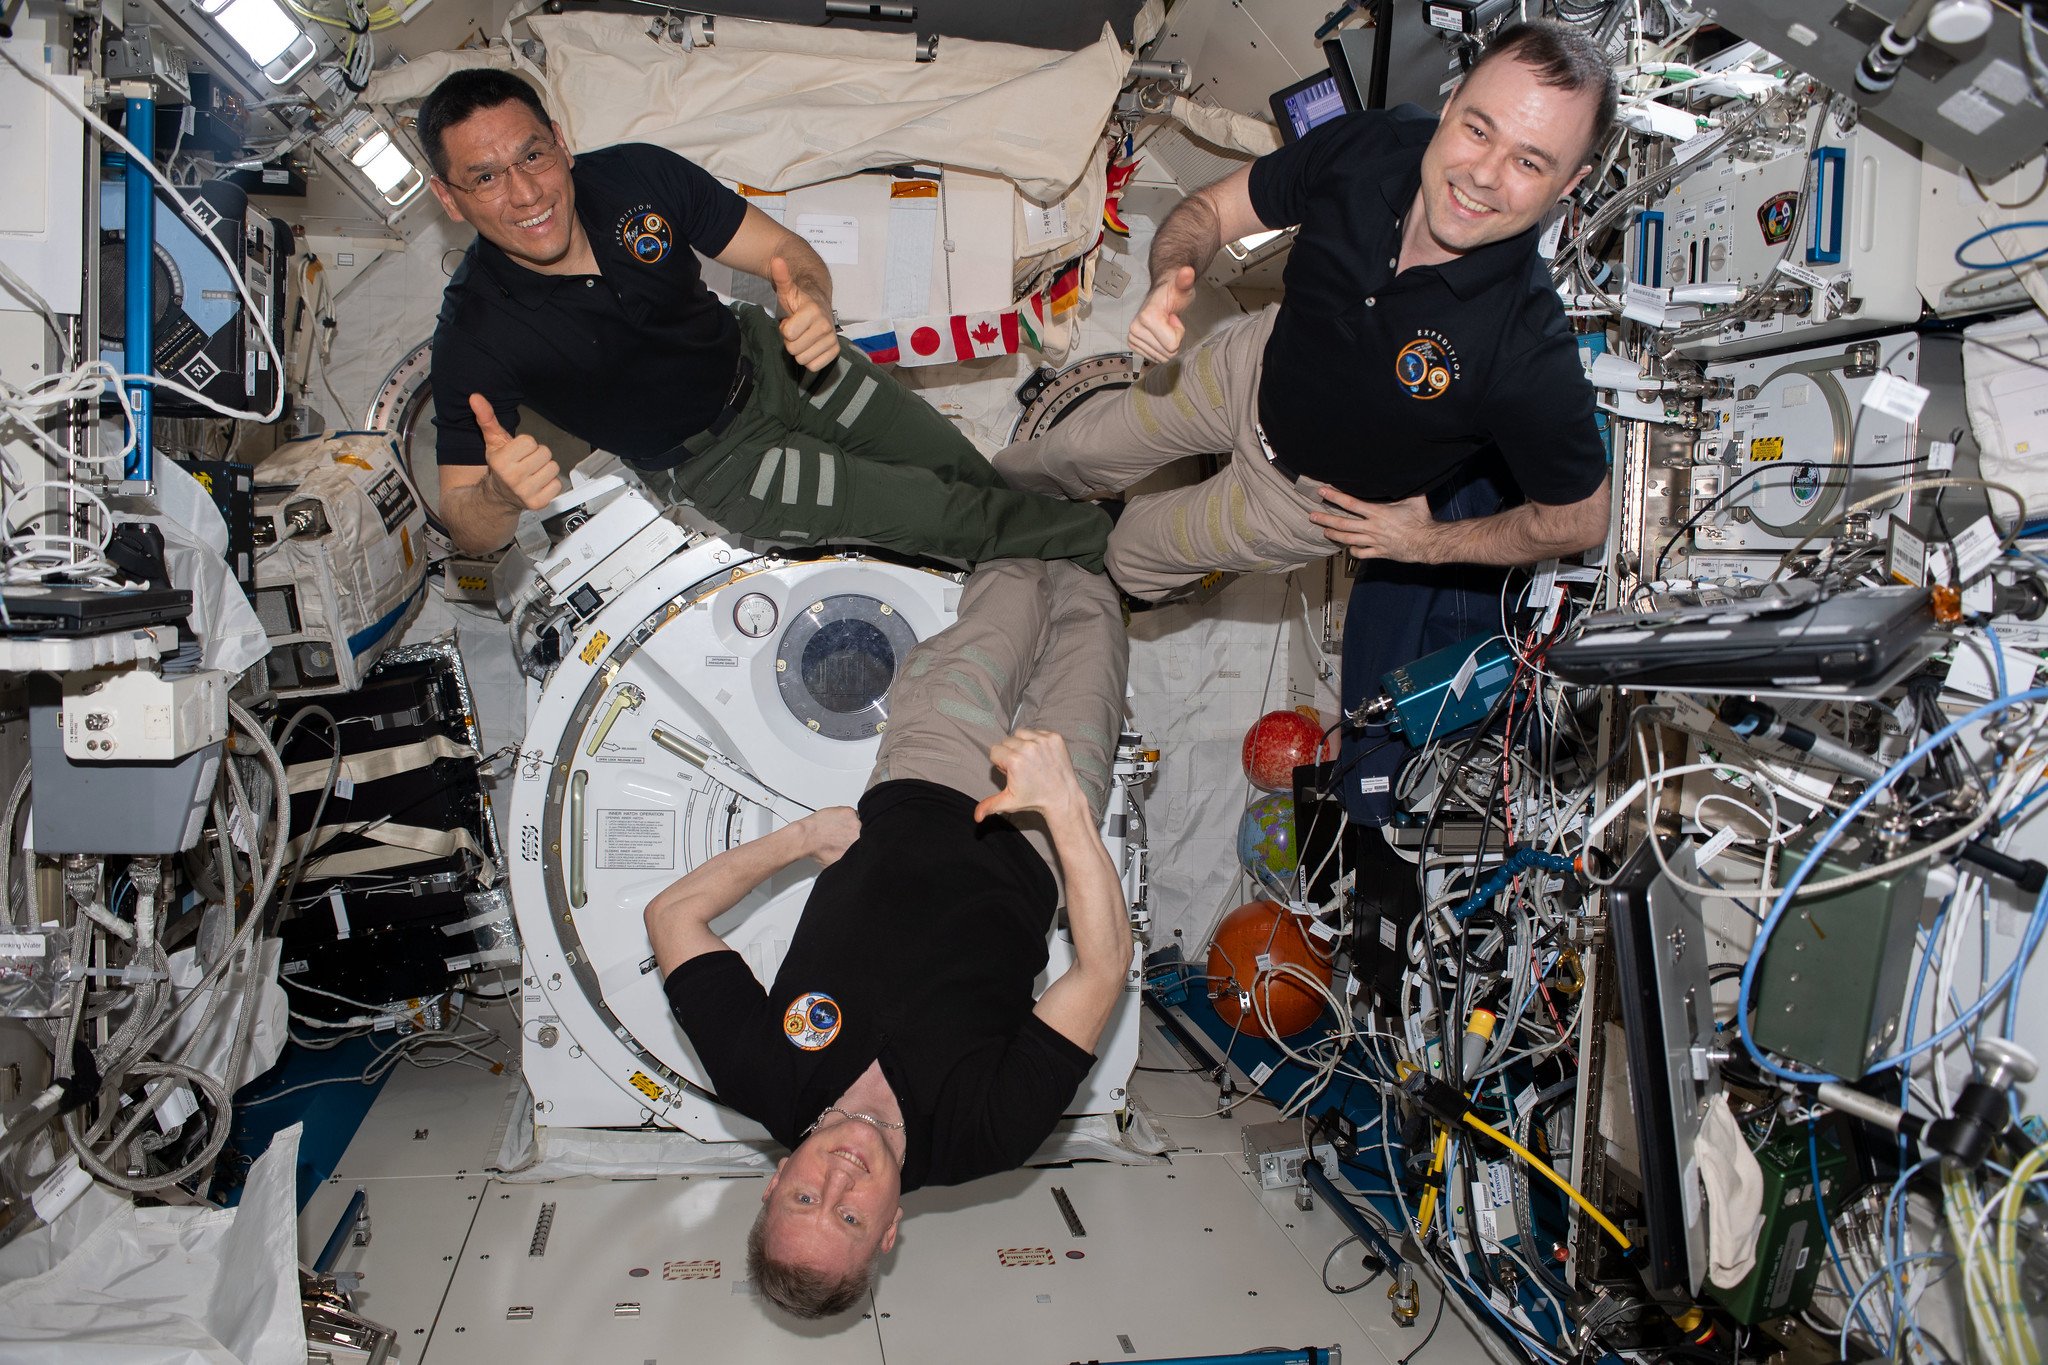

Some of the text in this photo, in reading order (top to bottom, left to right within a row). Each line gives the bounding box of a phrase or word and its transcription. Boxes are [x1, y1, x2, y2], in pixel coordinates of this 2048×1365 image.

[615, 203, 652, 246] EXPEDITION
[1809, 278, 1823, 287] RETURN
[1840, 271, 1852, 279] OPEN
[1417, 329, 1460, 380] EXPEDITION
[369, 492, 381, 506] Do
[375, 480, 391, 499] NOT
[1493, 1168, 1504, 1201] ATTENTION
